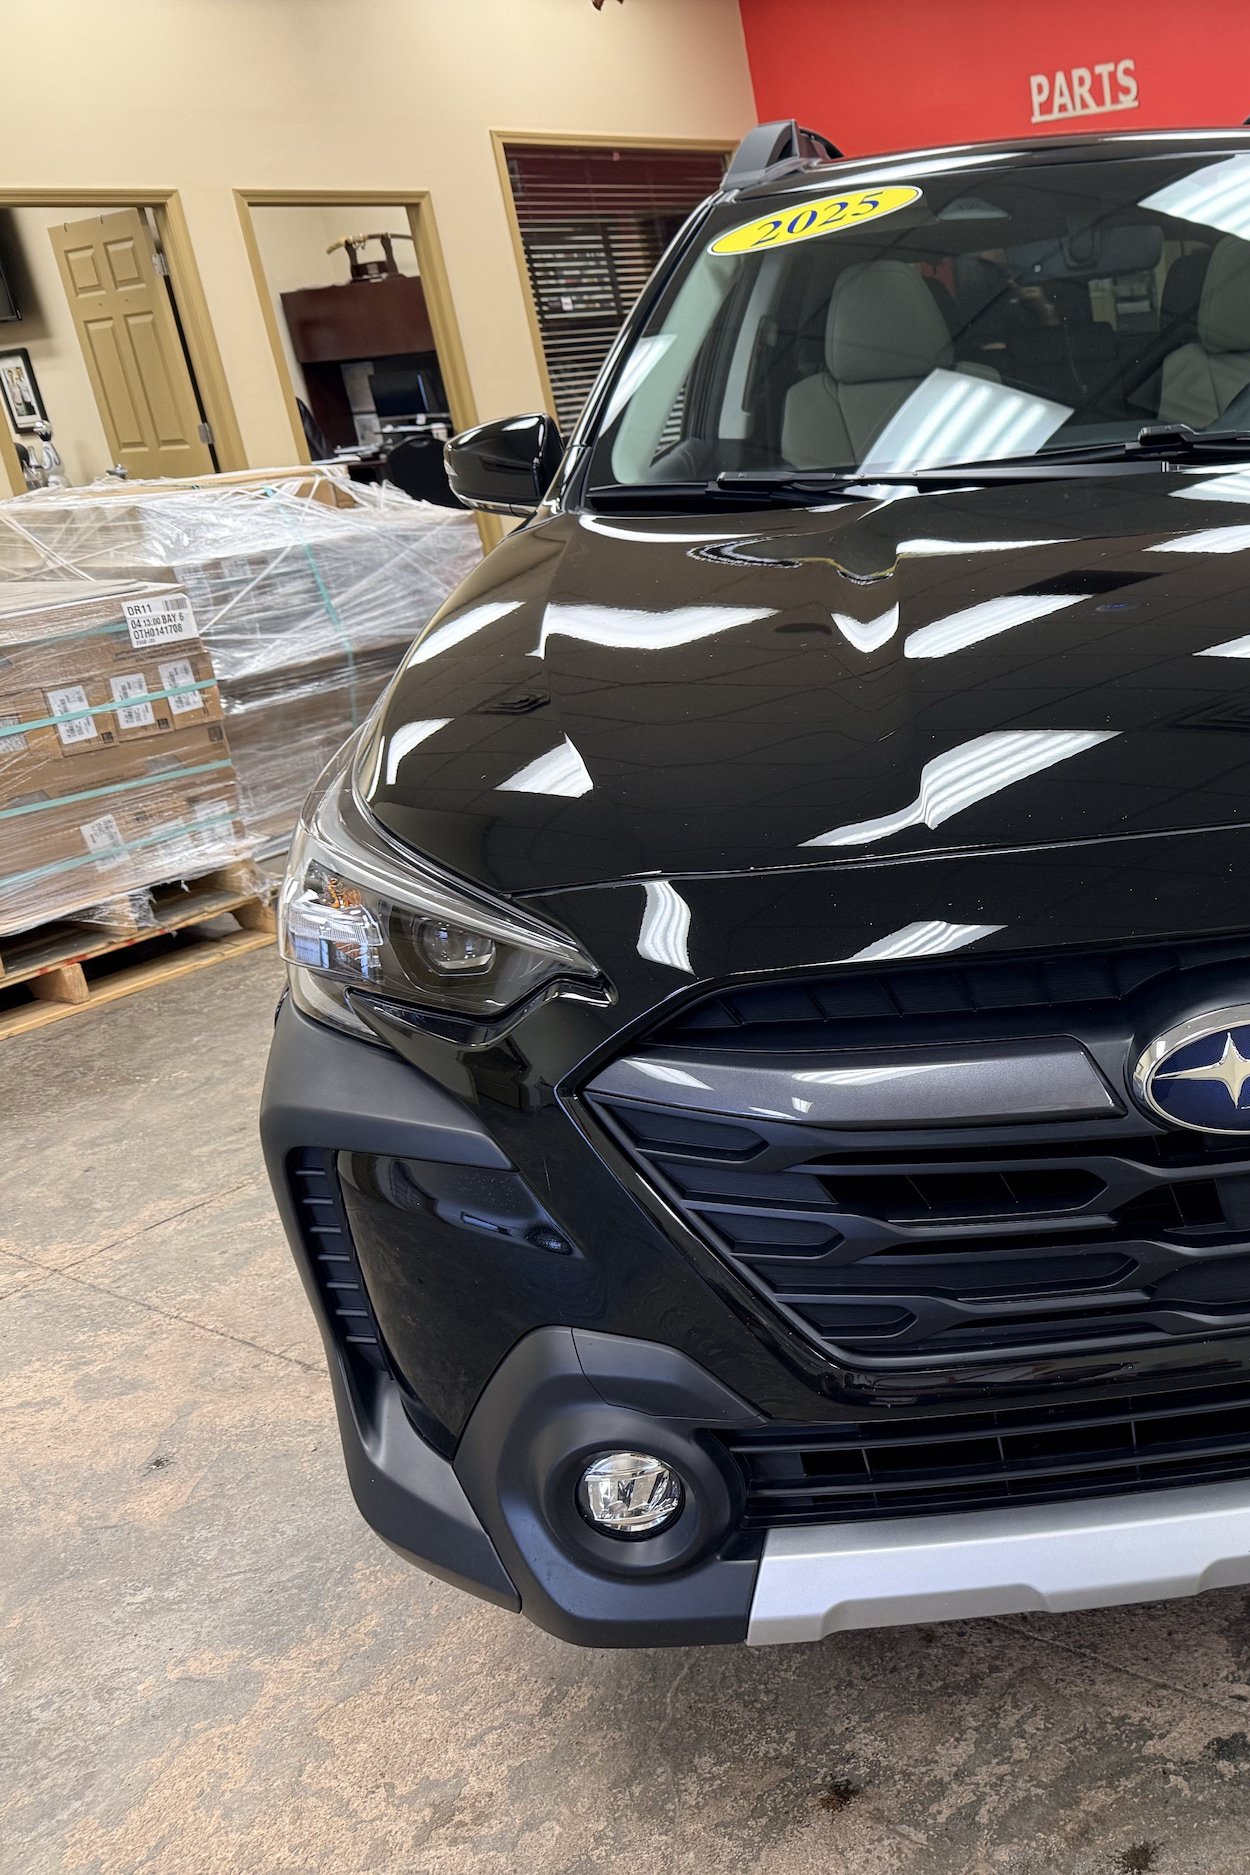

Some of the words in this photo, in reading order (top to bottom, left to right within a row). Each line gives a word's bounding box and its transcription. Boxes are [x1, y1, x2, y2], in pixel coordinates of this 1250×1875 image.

[1030, 58, 1138, 121] PARTS
[750, 191, 884, 247] 2025
[127, 603, 152, 616] DR11
[161, 613, 177, 624] BAY
